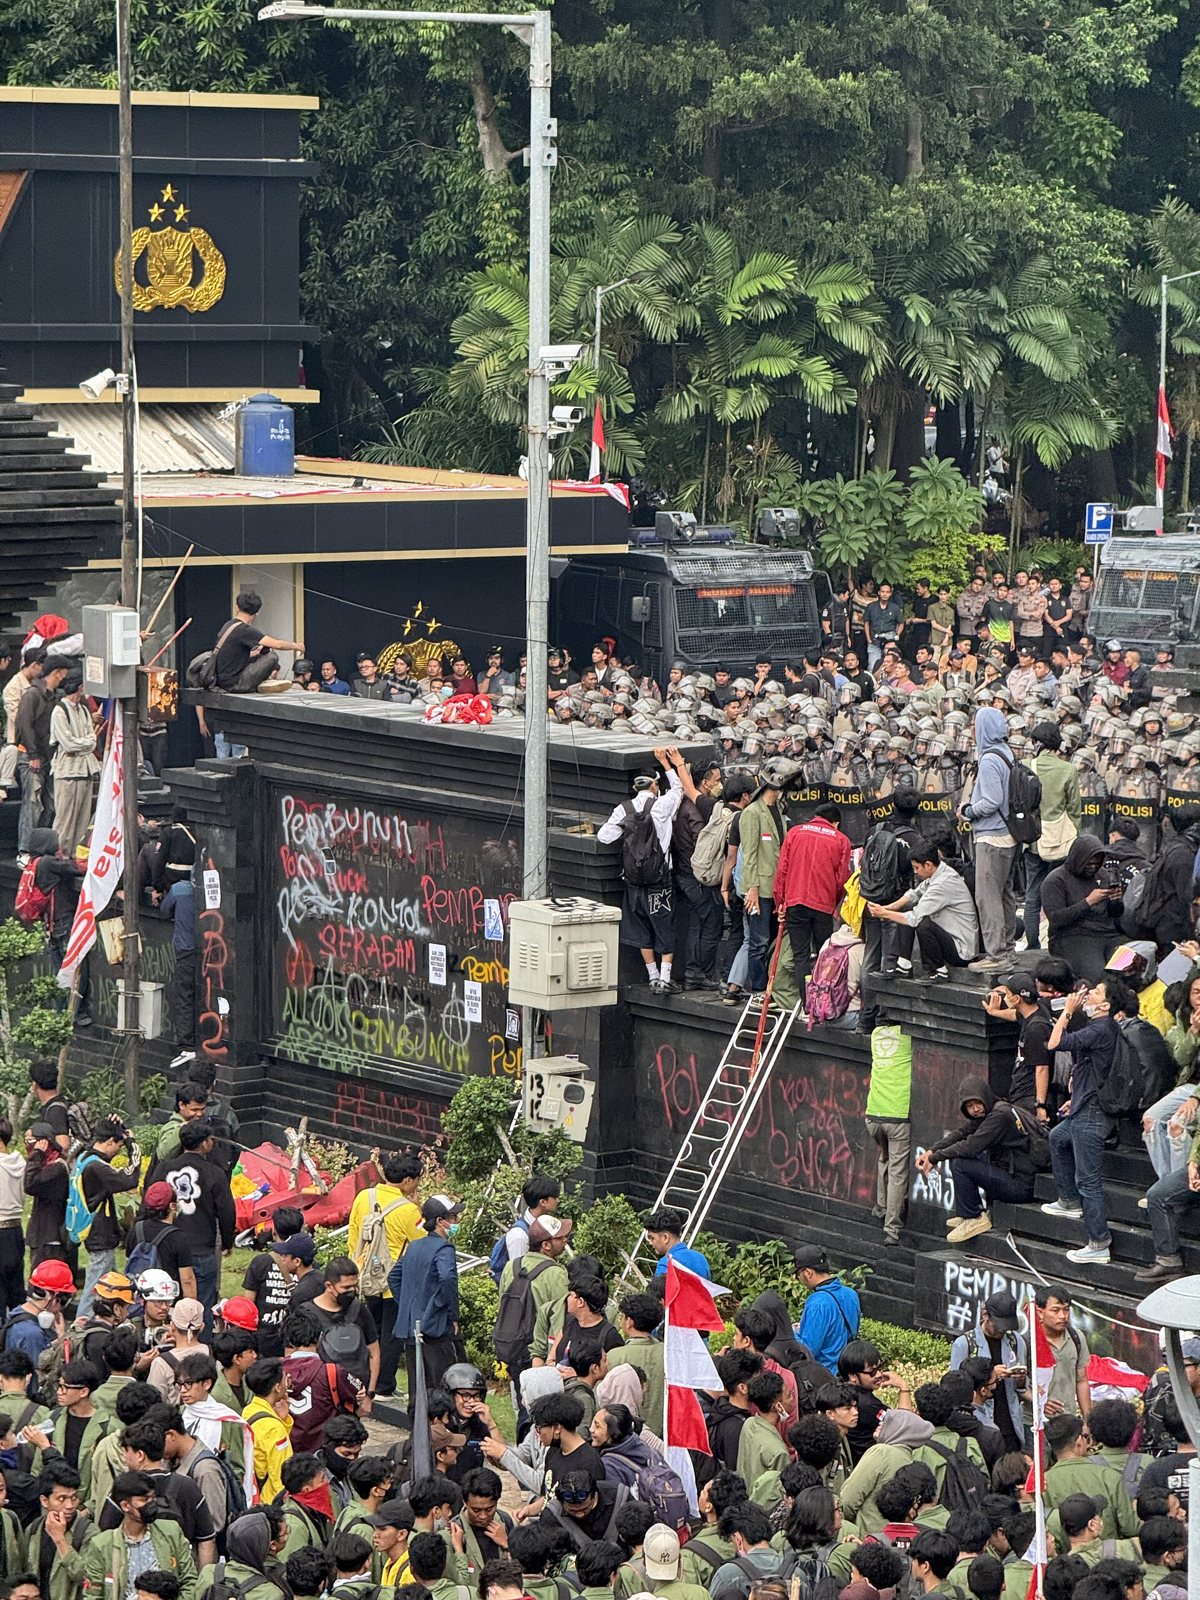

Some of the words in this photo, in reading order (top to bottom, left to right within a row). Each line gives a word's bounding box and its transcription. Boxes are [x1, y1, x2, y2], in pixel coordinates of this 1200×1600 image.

[1092, 506, 1107, 529] P
[791, 790, 820, 802] OLISI
[828, 791, 863, 805] POLISI
[872, 801, 895, 819] POLI
[1080, 804, 1100, 816] LISI
[1115, 803, 1153, 817] POLISI
[265, 1296, 290, 1305] MURD
